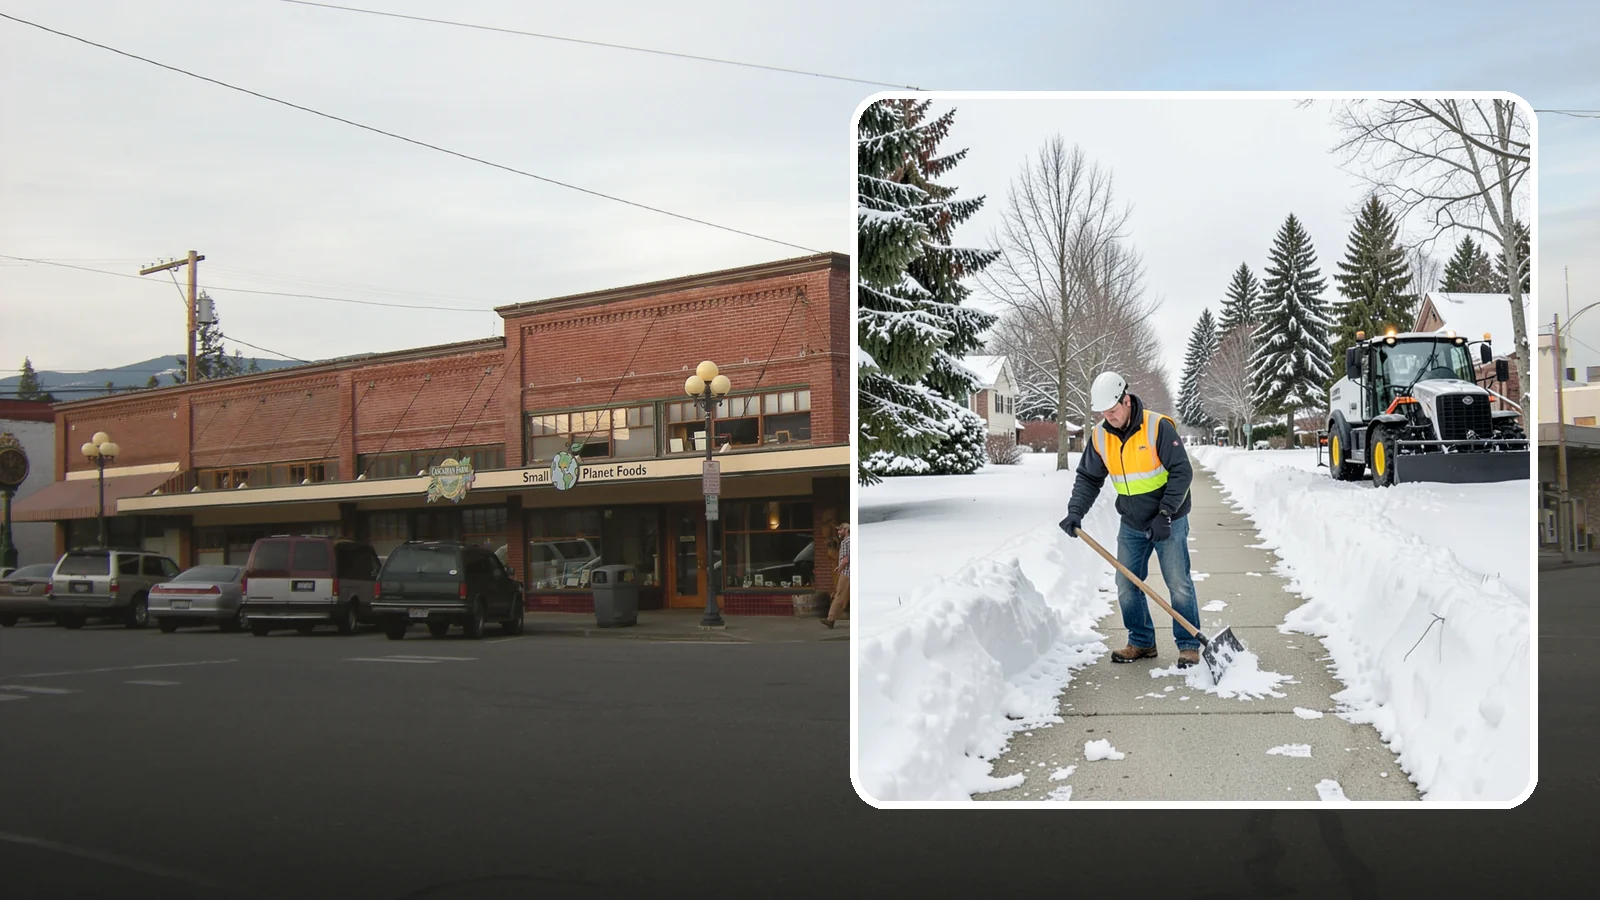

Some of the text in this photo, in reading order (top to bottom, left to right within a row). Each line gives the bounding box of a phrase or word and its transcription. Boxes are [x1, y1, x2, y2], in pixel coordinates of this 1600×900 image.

[523, 464, 647, 483] Small Planet Foods
